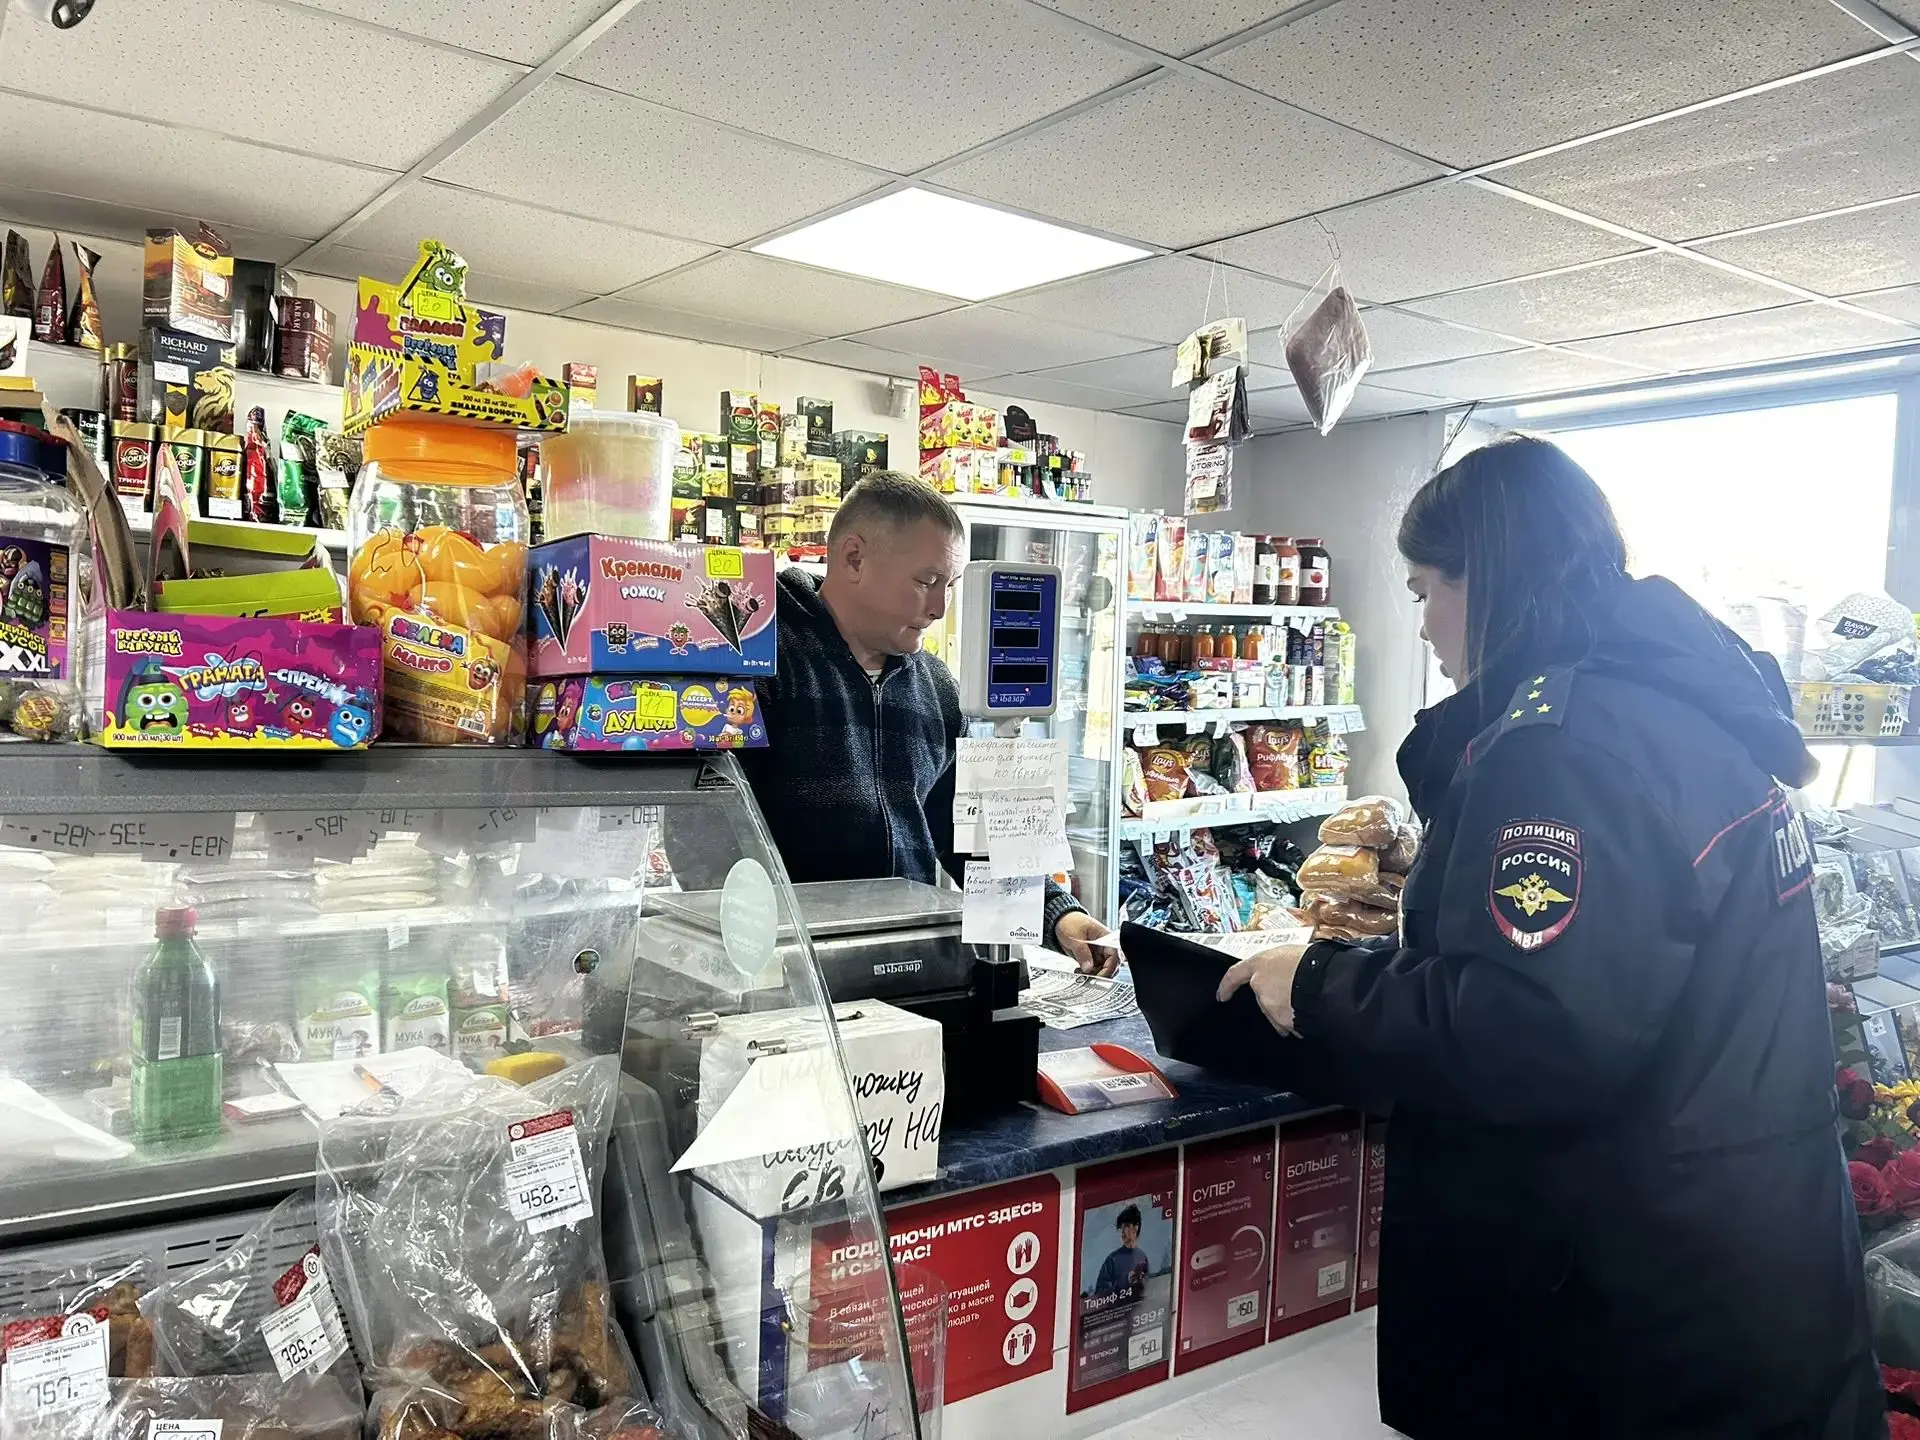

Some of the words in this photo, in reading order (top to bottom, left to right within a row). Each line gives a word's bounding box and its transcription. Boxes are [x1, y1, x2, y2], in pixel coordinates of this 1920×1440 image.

[293, 299, 302, 329] AKBAR
[161, 336, 208, 352] RICHARD
[488, 407, 527, 419] КОНФЕТА
[735, 416, 753, 425] Piala
[601, 558, 683, 582] Кремали
[621, 586, 667, 602] РОЖОК
[1843, 627, 1866, 637] SULU
[1844, 620, 1871, 632] BAYAN
[392, 645, 453, 673] МАНГО
[1502, 825, 1575, 847] ПОЛИЦИЯ
[1501, 851, 1571, 877] РОССИЯ
[1009, 930, 1039, 938] Ondutiss
[1511, 927, 1543, 949] МВД
[307, 1026, 343, 1040] МУКА
[395, 1030, 424, 1042] МУКА
[458, 1034, 482, 1045] МУКА
[1287, 1154, 1339, 1179] БОЛЬШЕ
[1192, 1179, 1236, 1203] СУПЕР
[947, 1214, 985, 1236] МТС
[988, 1200, 1043, 1225] ЗДЕСЬ
[968, 1295, 995, 1308] маске
[1084, 1292, 1118, 1309] Тариф
[1119, 1287, 1133, 1299] 24
[1132, 1310, 1157, 1328] 399
[1090, 1346, 1119, 1361] ТЕЛЕКОМ
